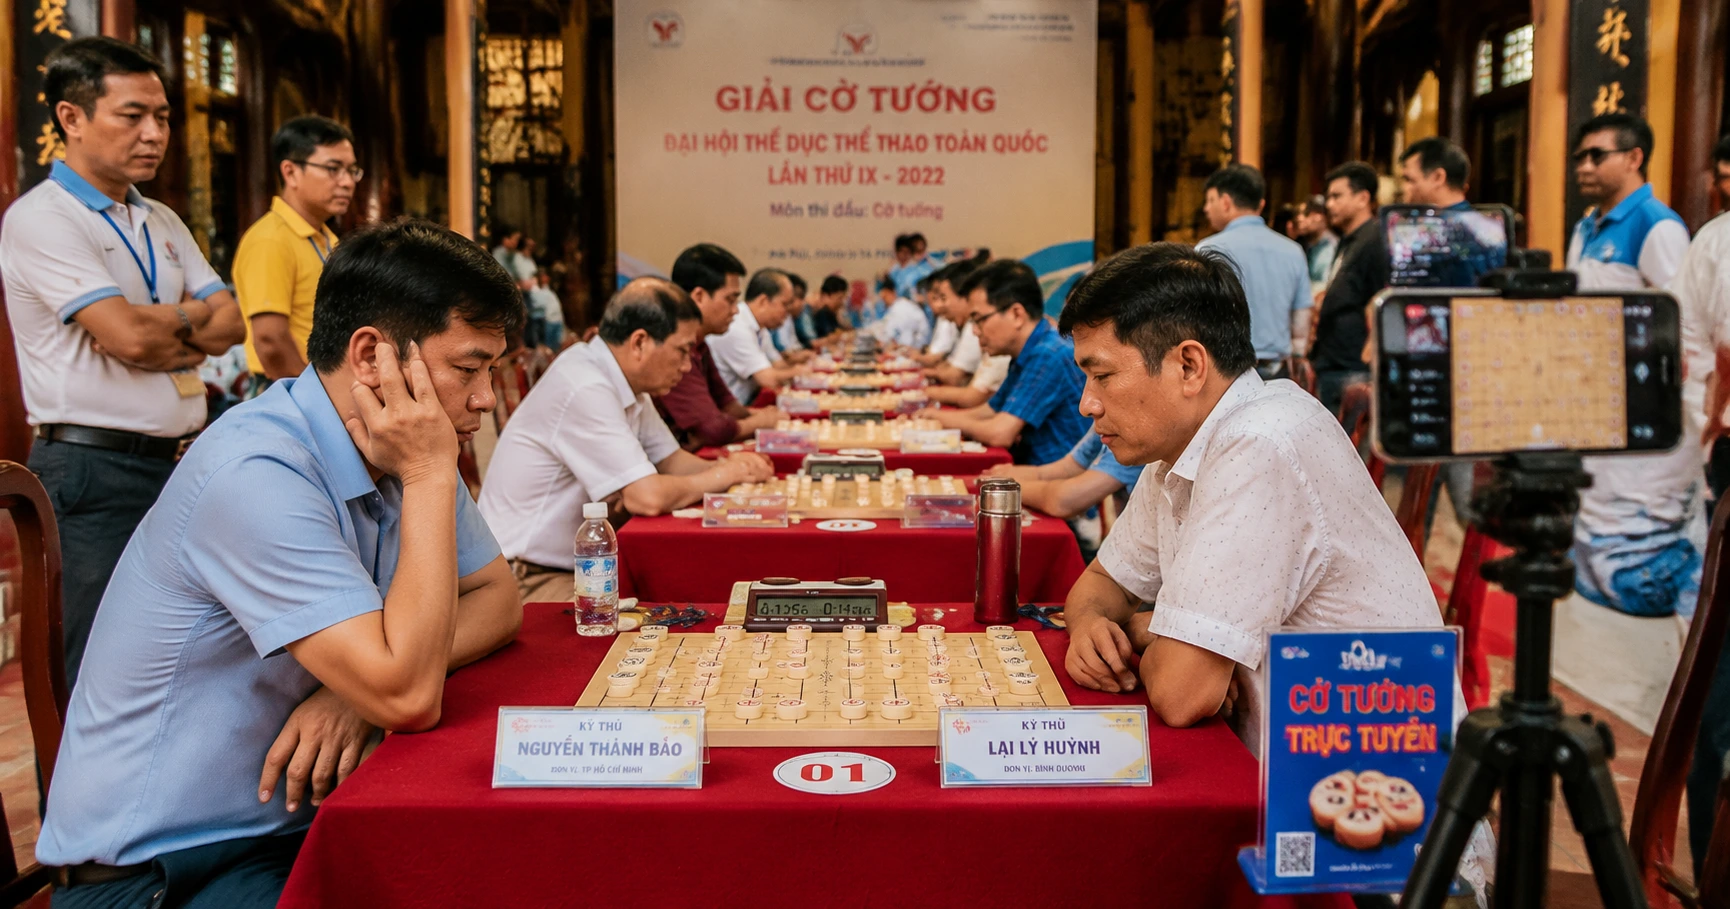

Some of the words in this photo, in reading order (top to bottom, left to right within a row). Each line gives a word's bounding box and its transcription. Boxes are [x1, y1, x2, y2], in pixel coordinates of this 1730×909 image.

[804, 78, 859, 113] CỜ
[868, 78, 996, 113] TƯỚNG
[786, 133, 828, 157] DỤC
[876, 133, 929, 152] THAO
[859, 166, 878, 185] IX
[898, 166, 945, 185] 2022
[988, 740, 1014, 759] LẠI
[800, 763, 866, 783] 01
